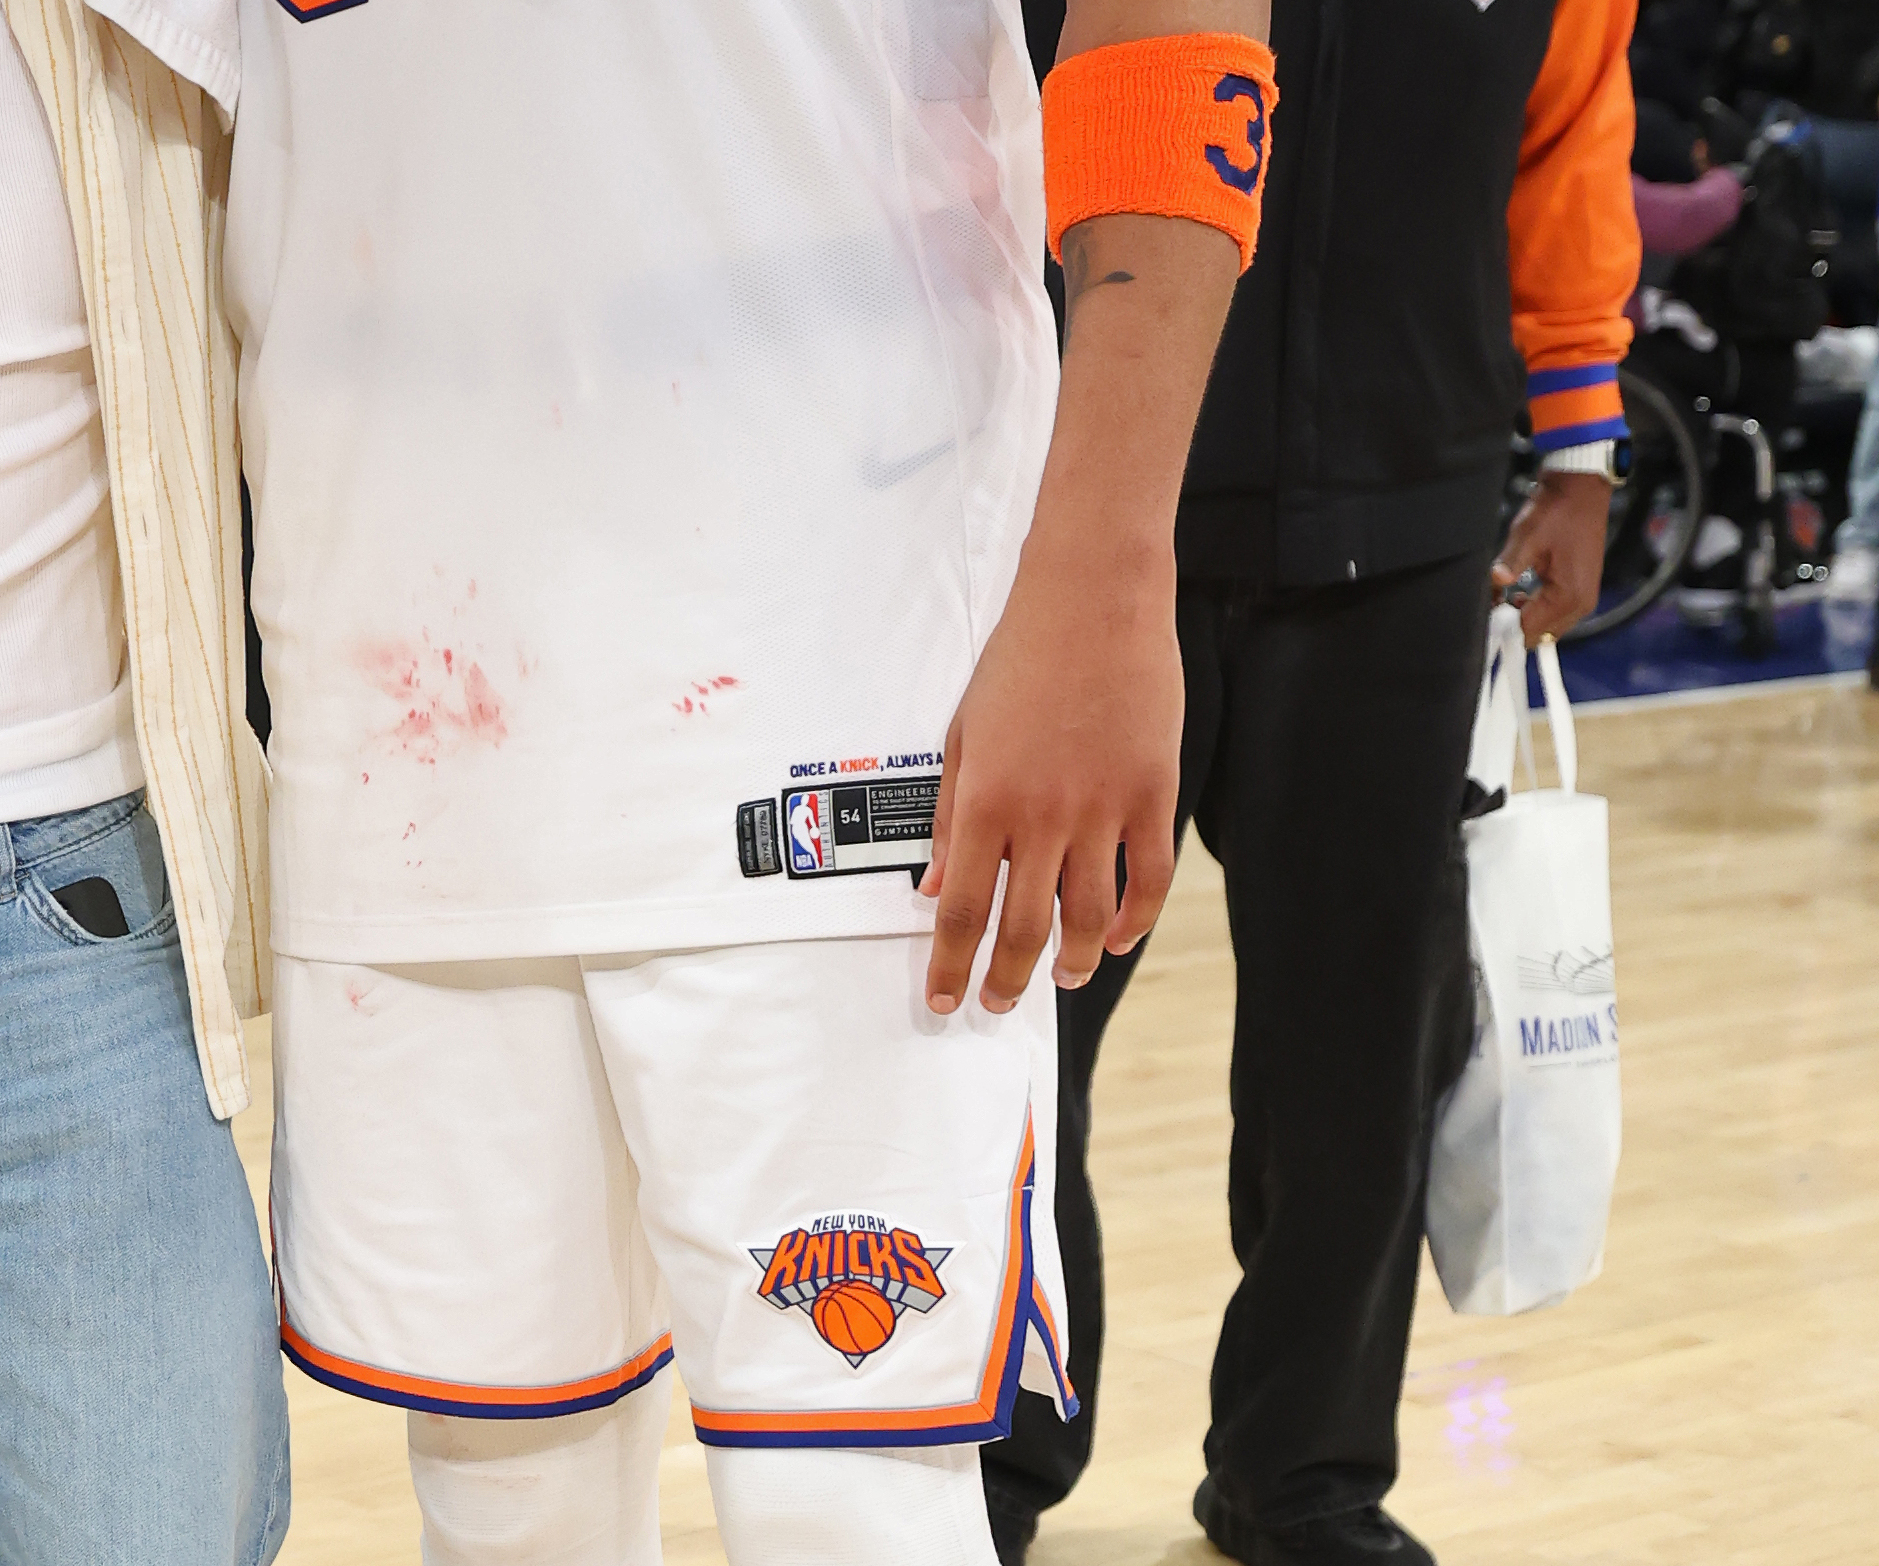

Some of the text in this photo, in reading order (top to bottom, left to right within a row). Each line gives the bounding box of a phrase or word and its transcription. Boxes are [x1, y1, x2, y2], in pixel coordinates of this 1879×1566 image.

[789, 762, 826, 778] ONCE
[828, 761, 838, 775] A
[840, 756, 884, 774] KNICK,
[886, 752, 934, 769] ALWAYS
[871, 786, 940, 800] ENGINEERED
[840, 807, 861, 824] 54
[811, 1213, 887, 1233] NEW YORK
[757, 1227, 947, 1301] KNICKS
